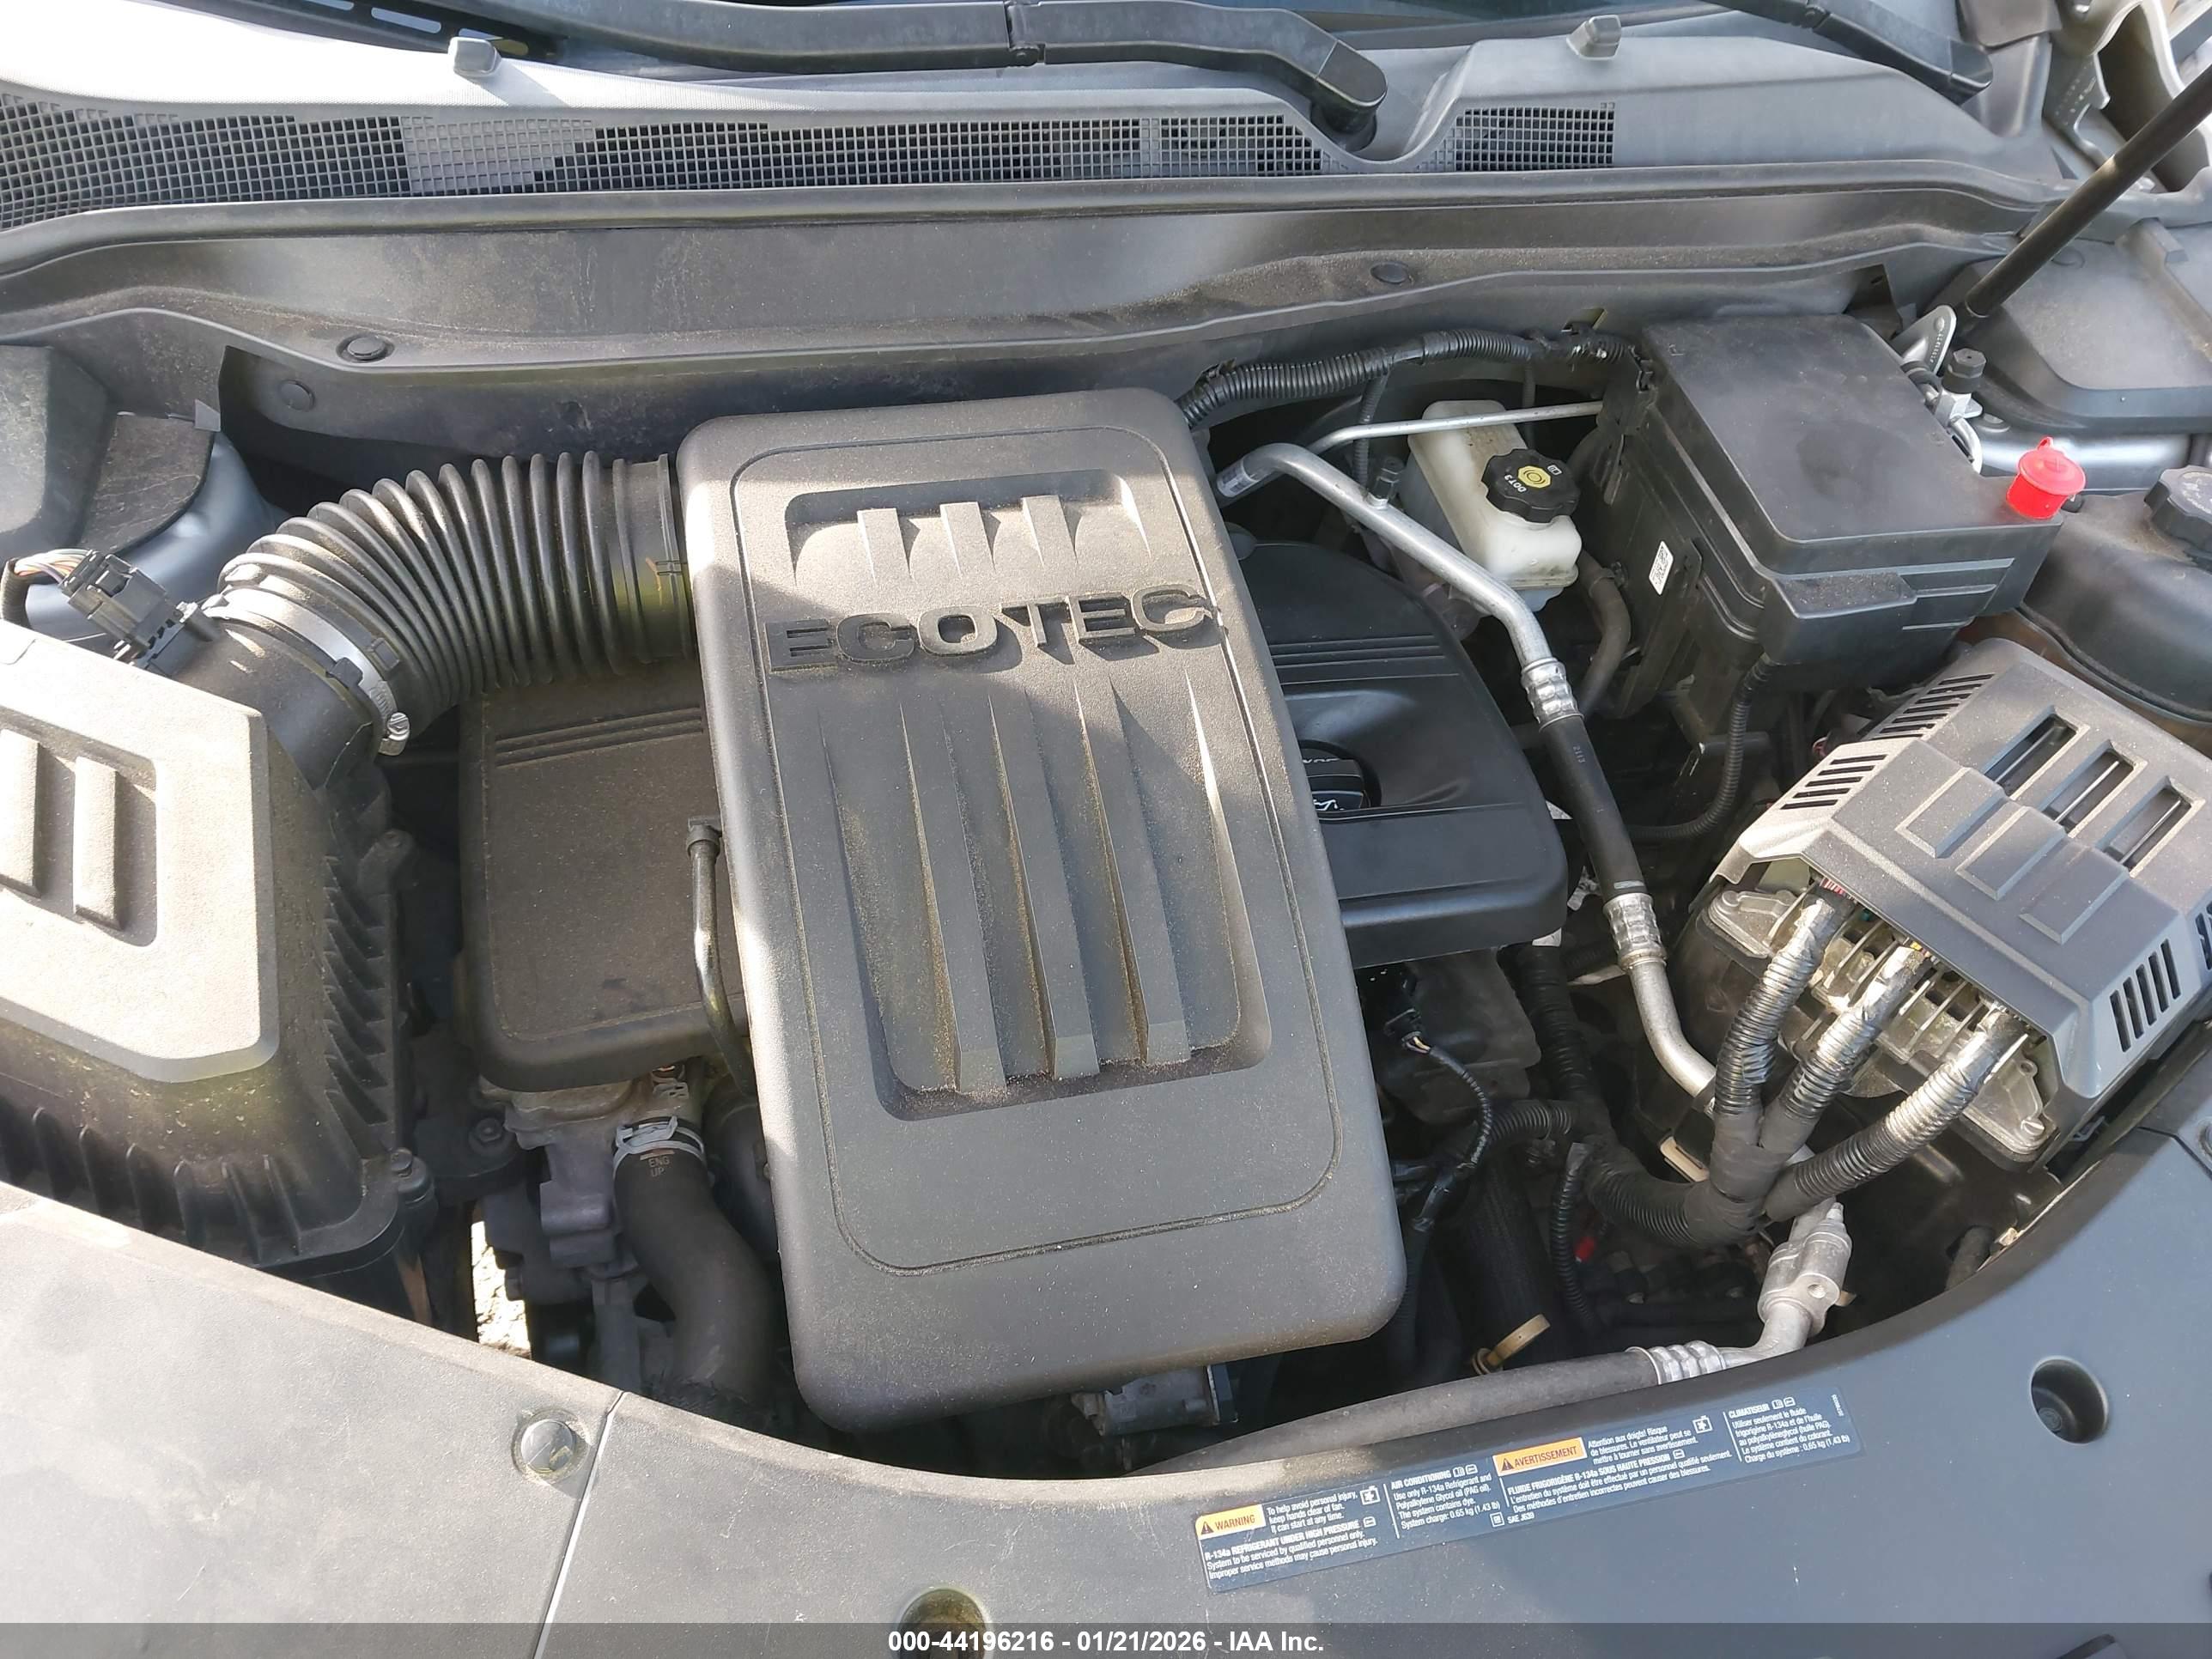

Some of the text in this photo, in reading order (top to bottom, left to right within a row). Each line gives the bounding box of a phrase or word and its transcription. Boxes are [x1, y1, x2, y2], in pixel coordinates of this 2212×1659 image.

[1504, 474, 1527, 492] DOT3
[763, 583, 1211, 672] ECOTEC
[1513, 1446, 1578, 1467] AVERTISSEMENT
[1214, 1513, 1256, 1530] WARNING
